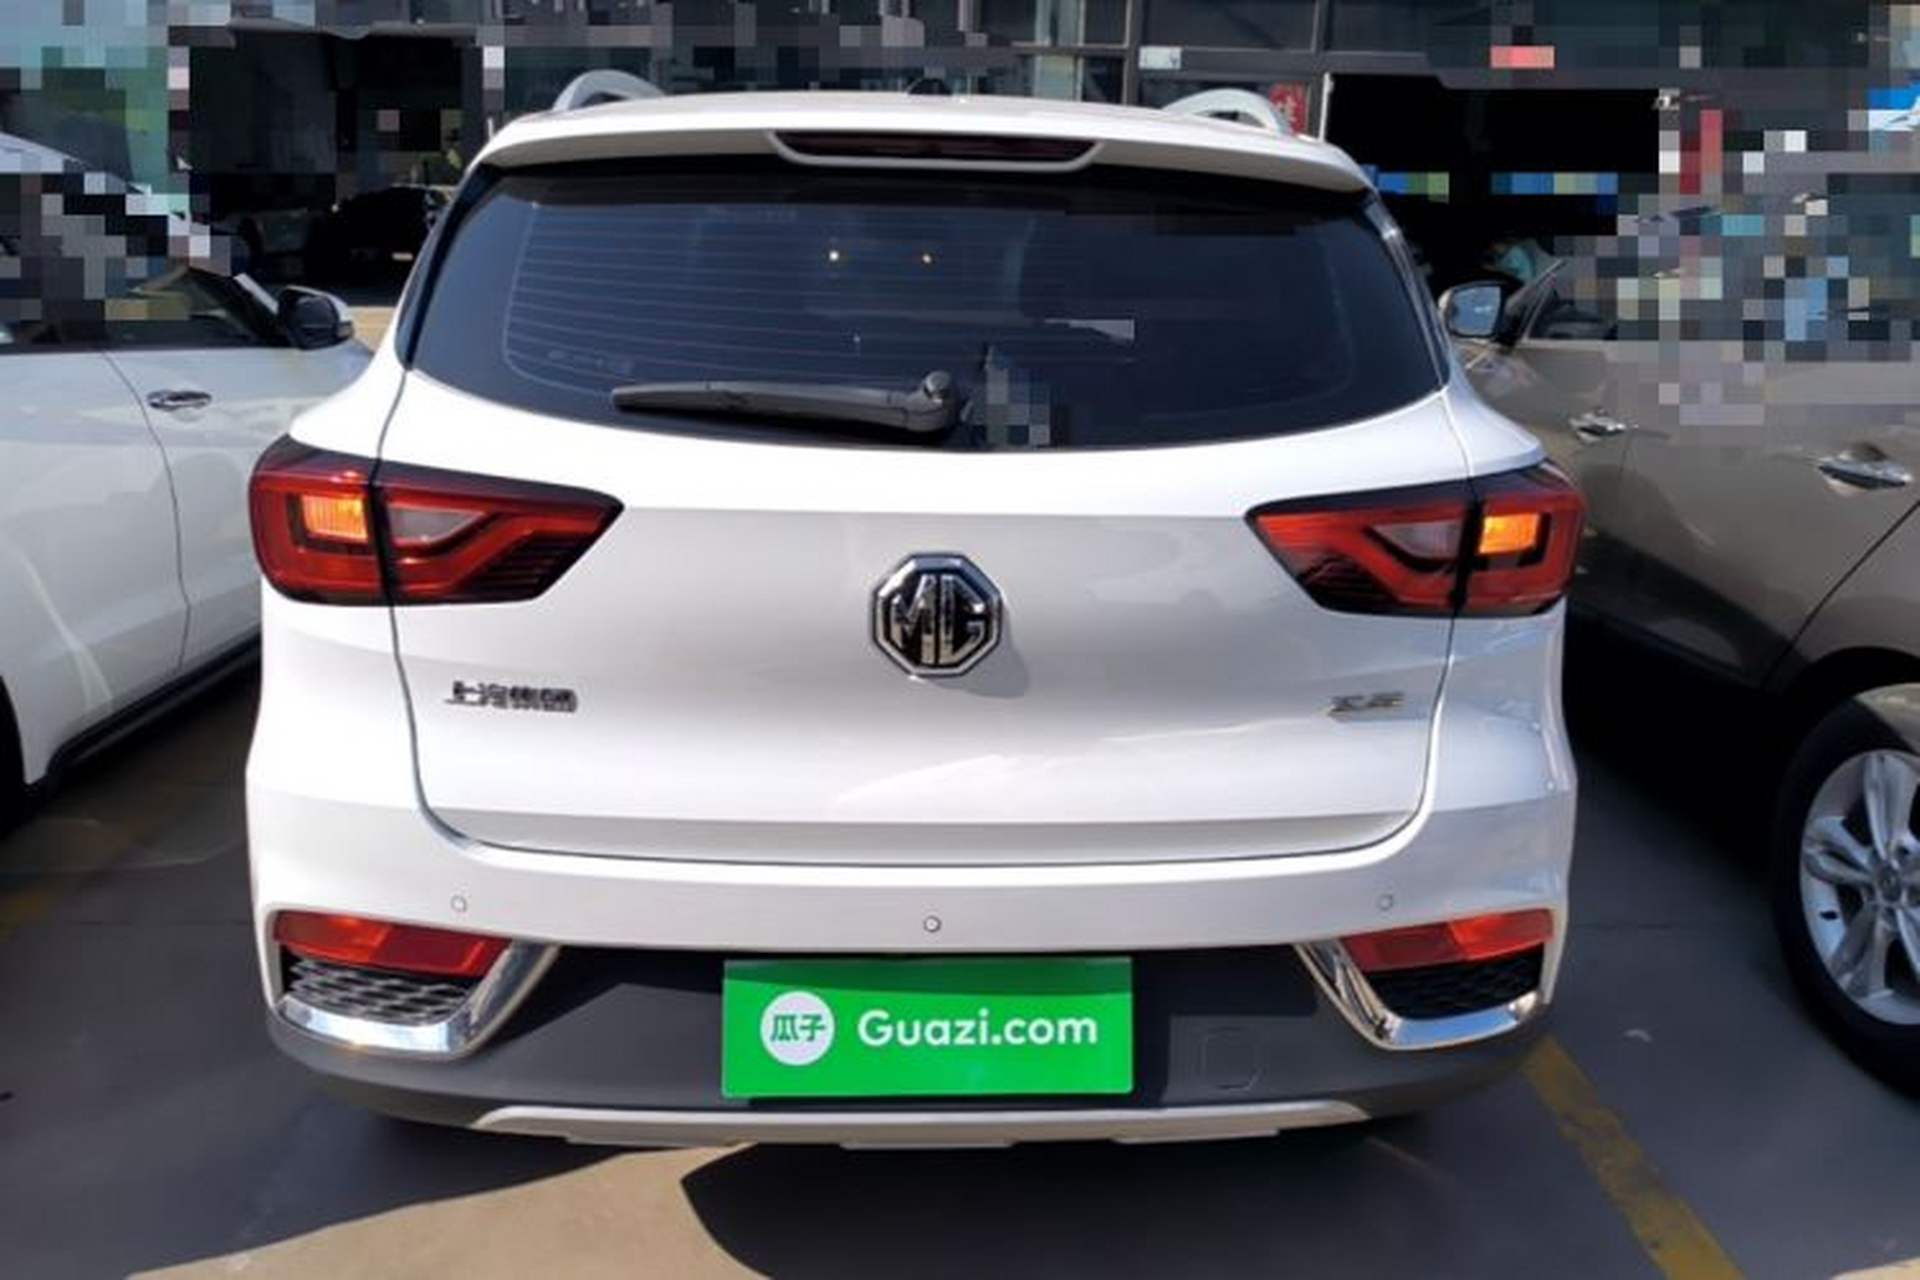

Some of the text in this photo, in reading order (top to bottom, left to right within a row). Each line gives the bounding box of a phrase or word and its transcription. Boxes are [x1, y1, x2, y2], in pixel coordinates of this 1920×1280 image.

[889, 572, 989, 666] MG
[769, 1012, 826, 1043] 瓜子
[857, 1007, 1099, 1047] Guazi.com
